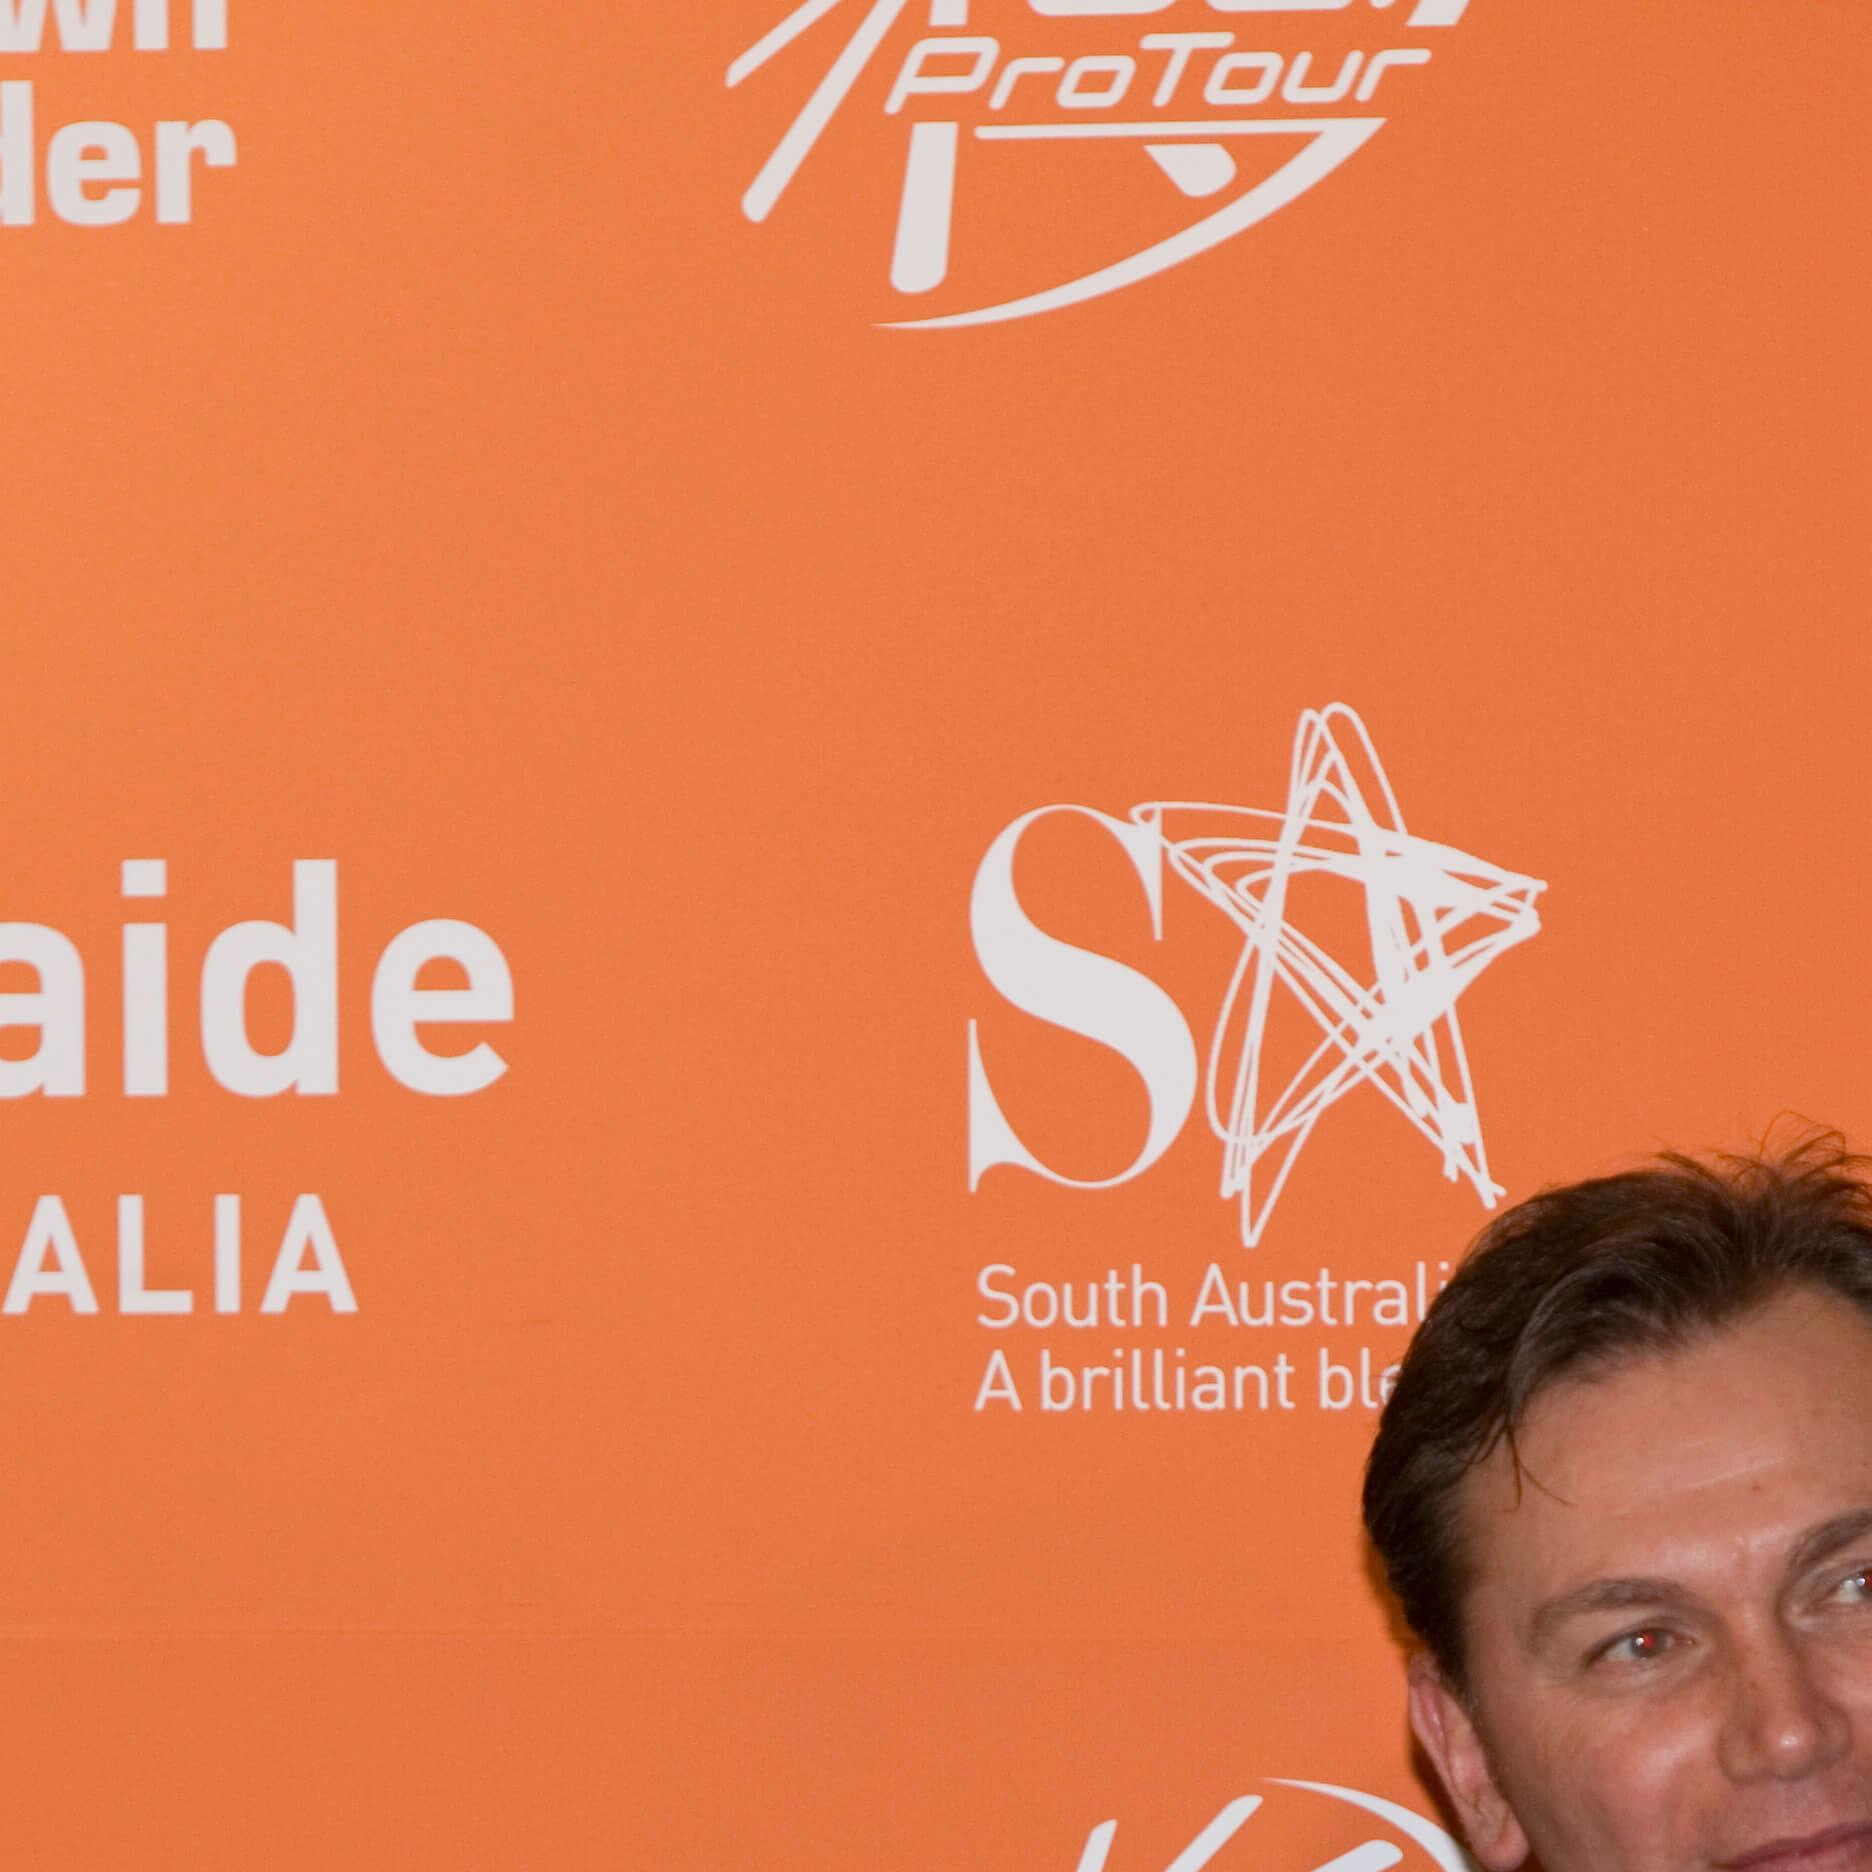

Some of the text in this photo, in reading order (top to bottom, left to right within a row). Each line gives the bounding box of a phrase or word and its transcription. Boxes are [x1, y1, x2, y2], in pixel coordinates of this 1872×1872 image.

[883, 32, 1432, 115] ProTour
[977, 1263, 1168, 1328] South
[973, 1348, 1023, 1412] A
[1039, 1348, 1296, 1412] brilliant
